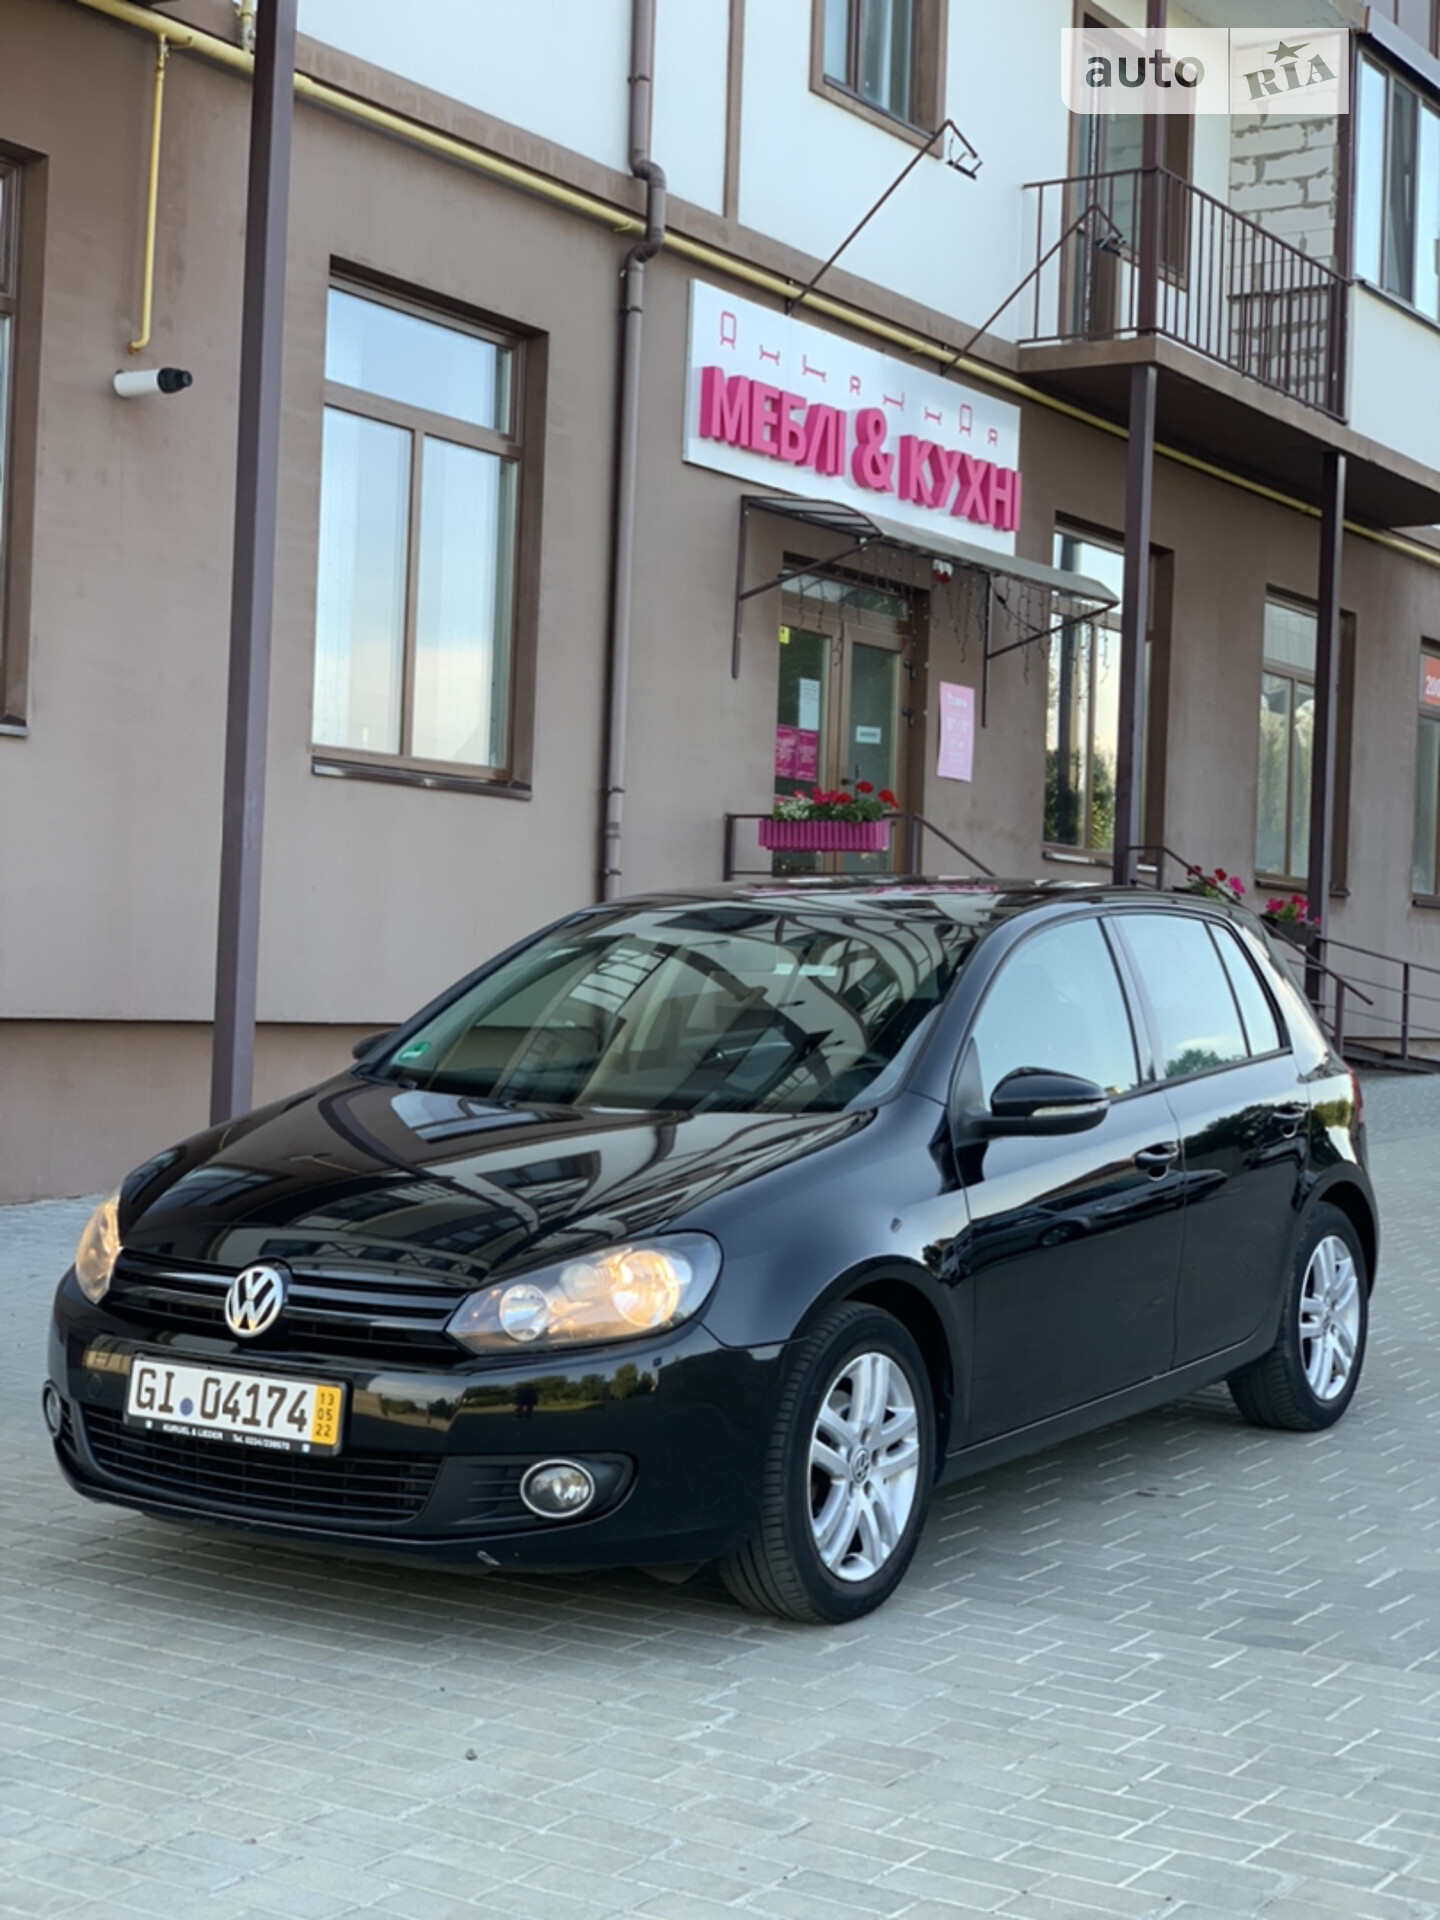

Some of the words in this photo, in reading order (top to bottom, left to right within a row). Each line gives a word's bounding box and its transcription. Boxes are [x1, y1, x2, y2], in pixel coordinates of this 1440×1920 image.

[699, 365, 847, 477] МЕБЛІ
[852, 407, 894, 493] &
[897, 434, 1022, 532] КУХНІ
[135, 1367, 175, 1414] GI
[199, 1376, 308, 1433] 04174
[315, 1423, 332, 1438] 22
